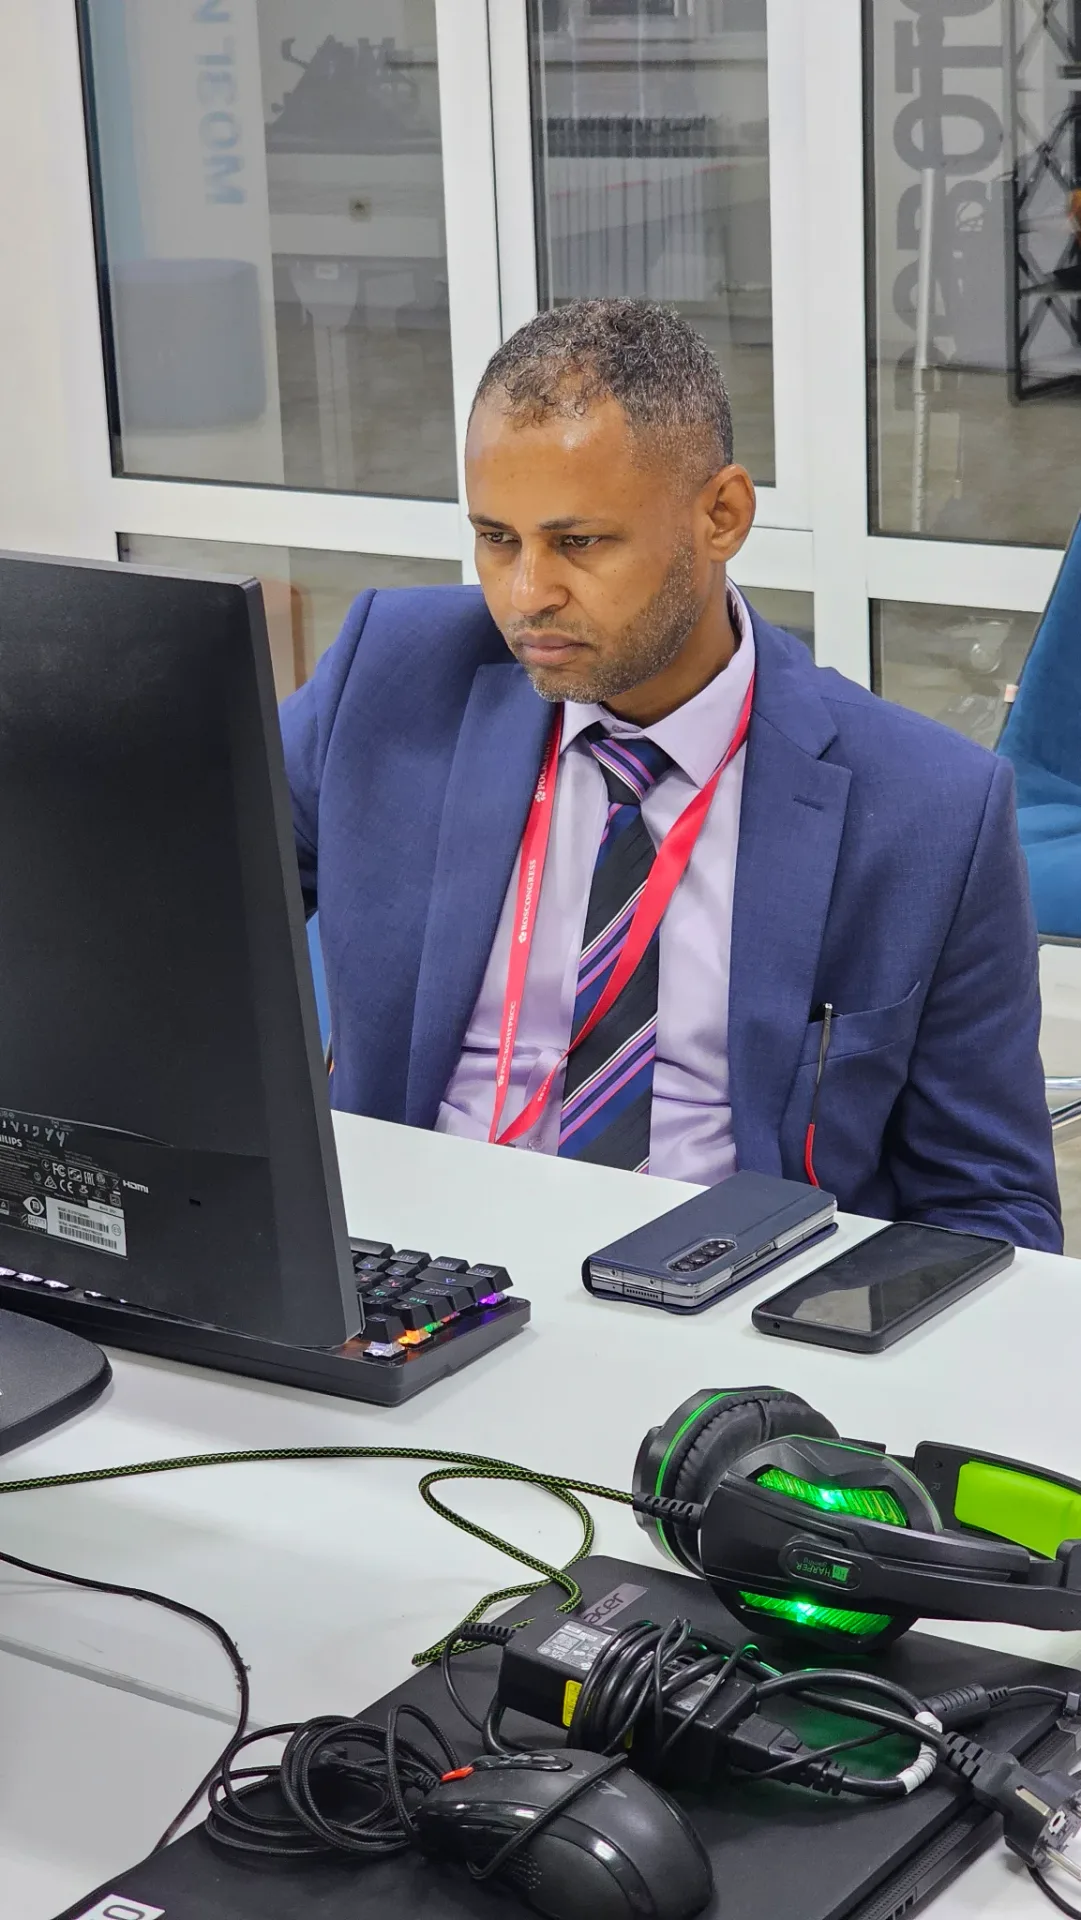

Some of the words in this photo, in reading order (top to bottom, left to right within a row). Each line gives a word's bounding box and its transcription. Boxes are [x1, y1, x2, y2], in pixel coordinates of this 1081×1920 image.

[521, 859, 537, 931] ROSCONGRESS
[796, 1561, 831, 1577] HARPER
[583, 1592, 624, 1624] acer
